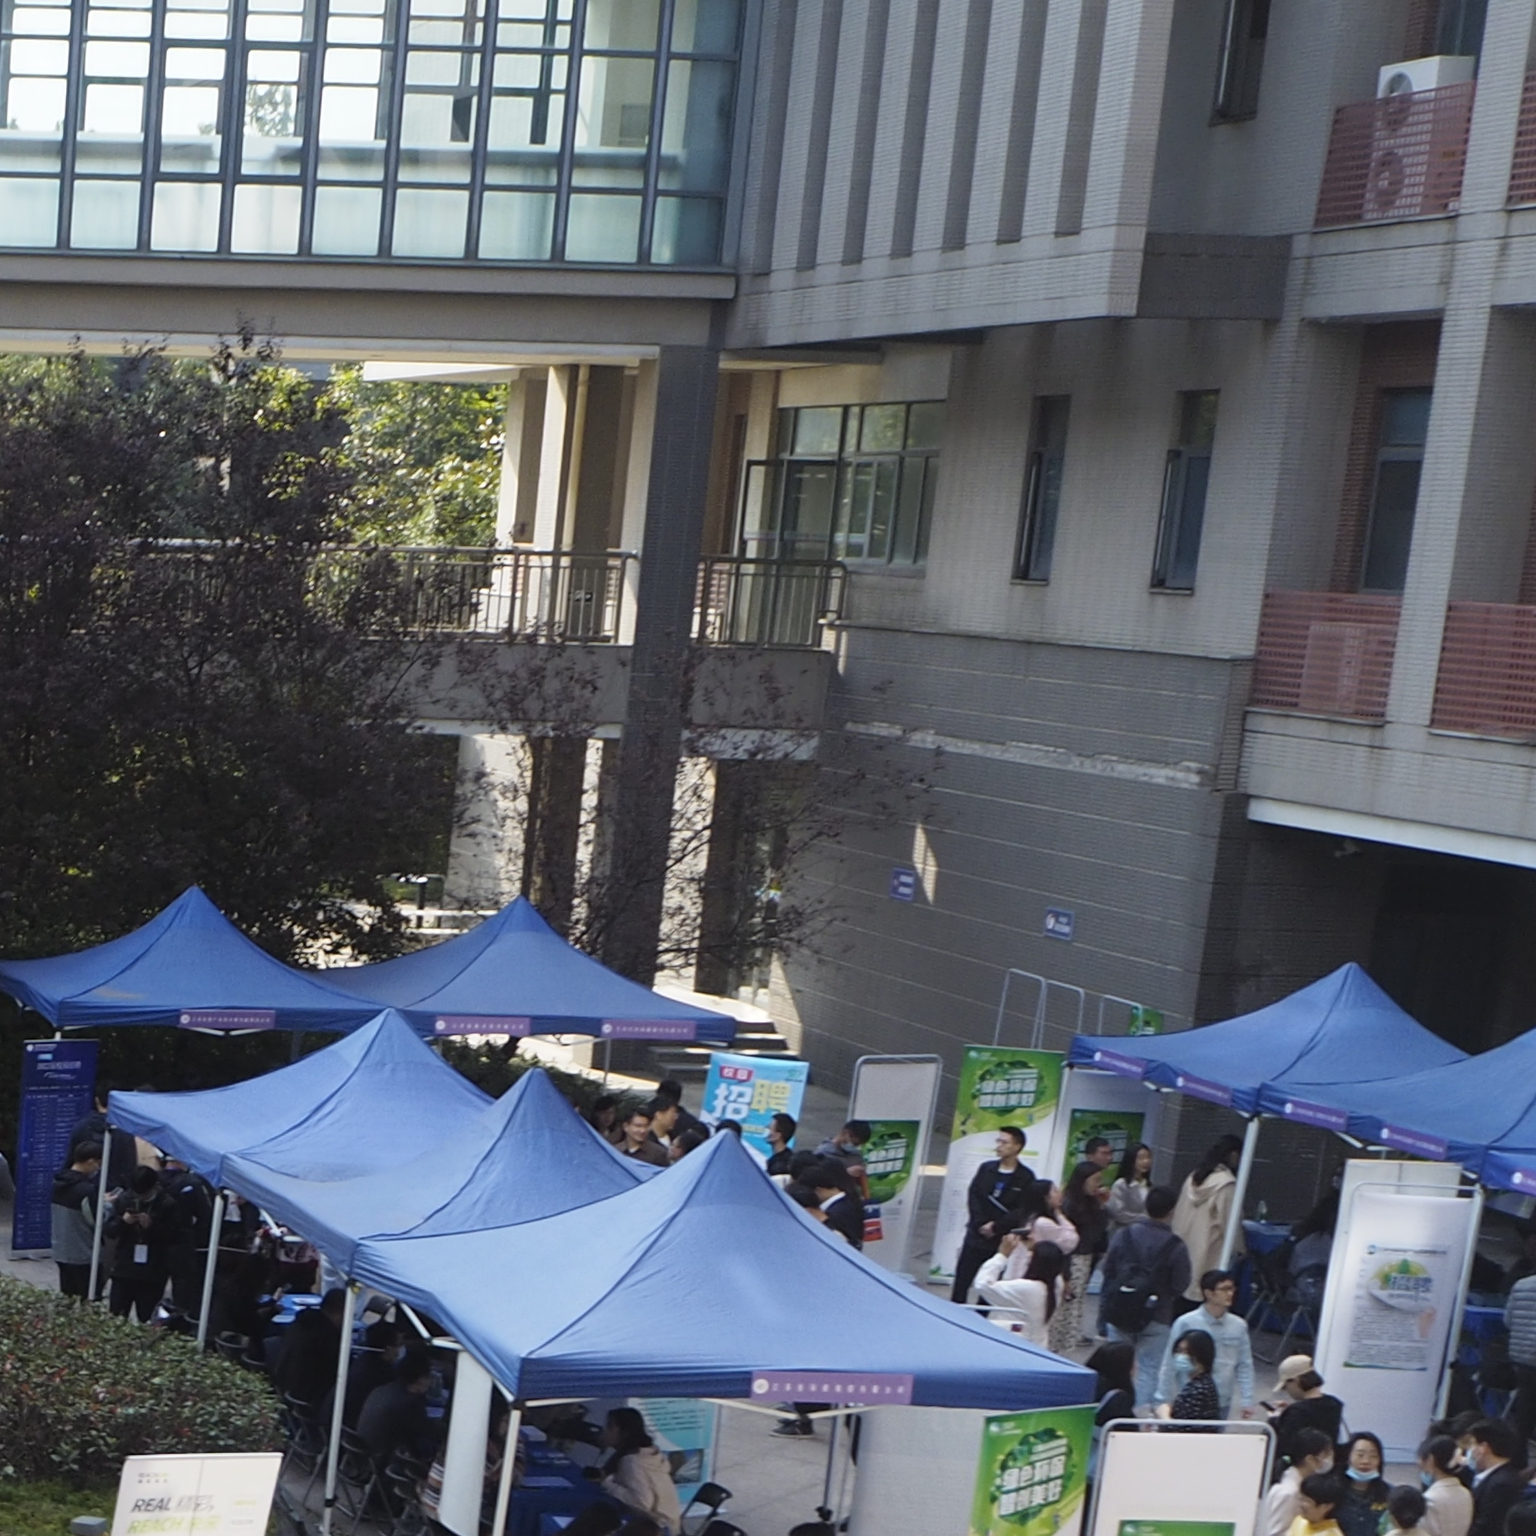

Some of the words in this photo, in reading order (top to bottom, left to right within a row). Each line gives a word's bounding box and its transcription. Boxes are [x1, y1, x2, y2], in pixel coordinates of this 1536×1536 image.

[712, 1080, 791, 1121] 招聘
[1002, 1455, 1067, 1491] 绿色环保
[130, 1497, 172, 1513] REAL
